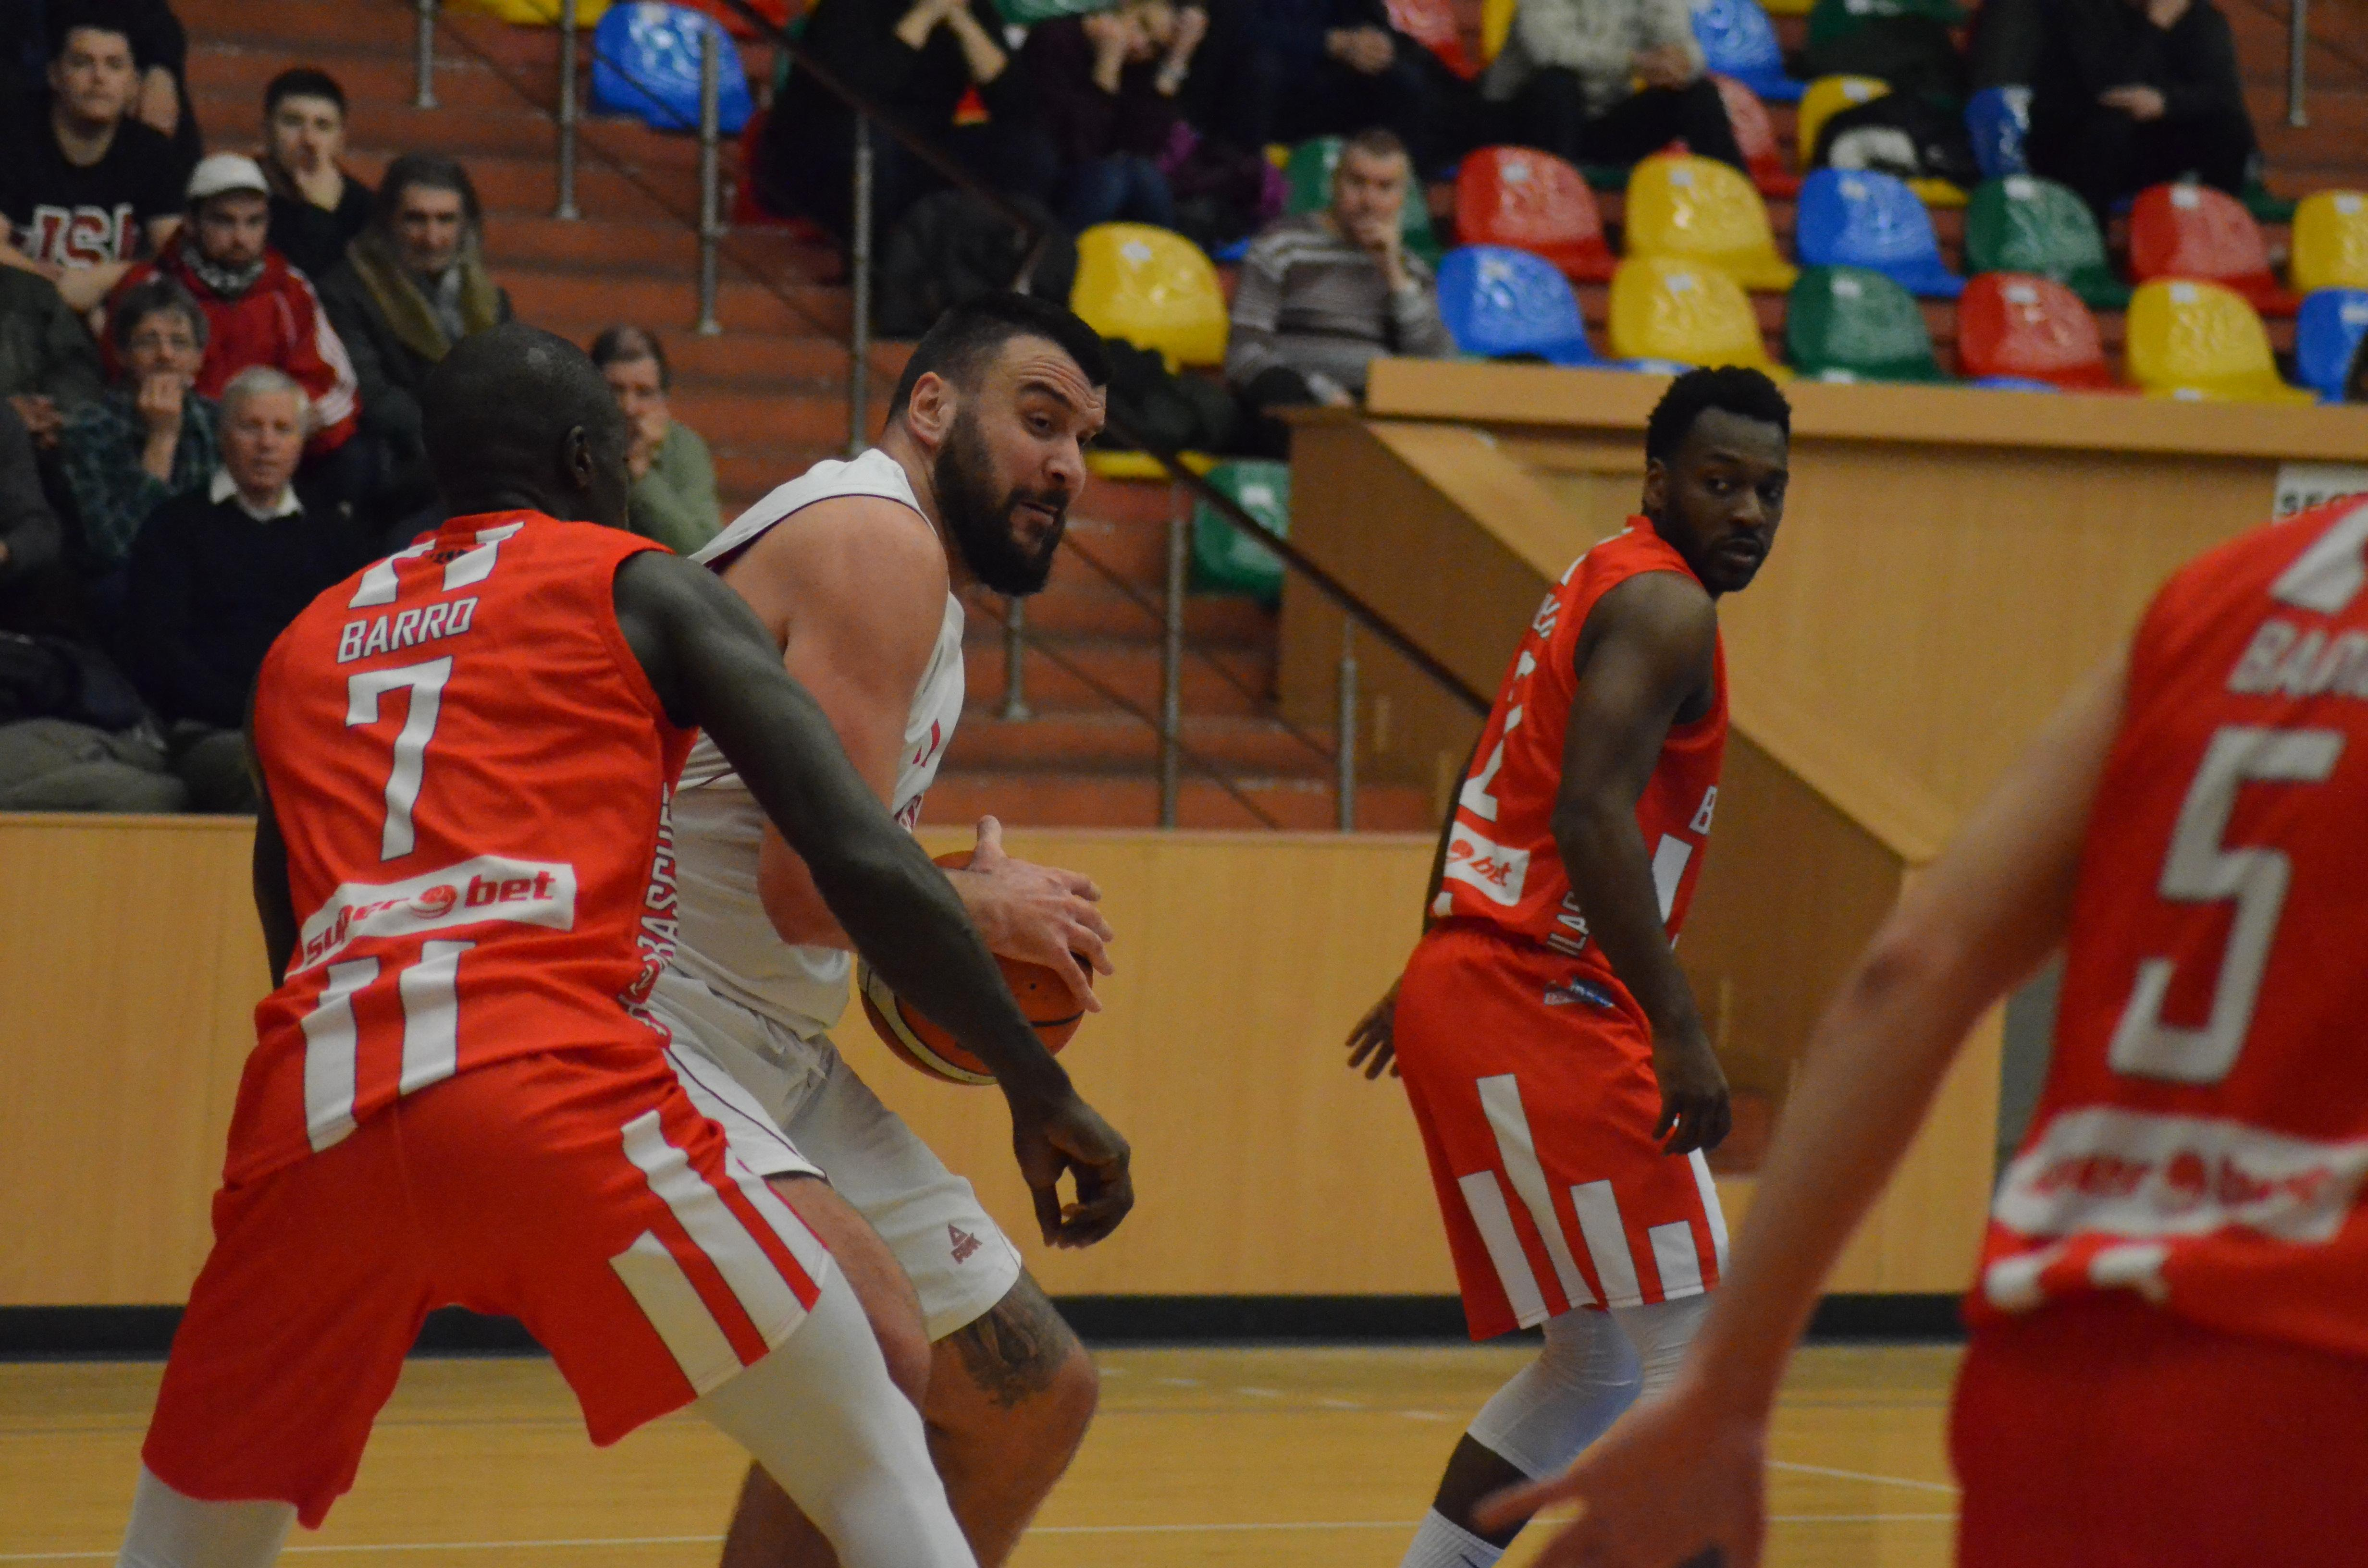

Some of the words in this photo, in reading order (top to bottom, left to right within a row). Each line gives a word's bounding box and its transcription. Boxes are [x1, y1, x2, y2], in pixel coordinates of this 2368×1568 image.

[337, 596, 480, 664] BARRO
[345, 654, 451, 862] 7
[464, 870, 556, 909] bet
[2109, 724, 2347, 1086] 5
